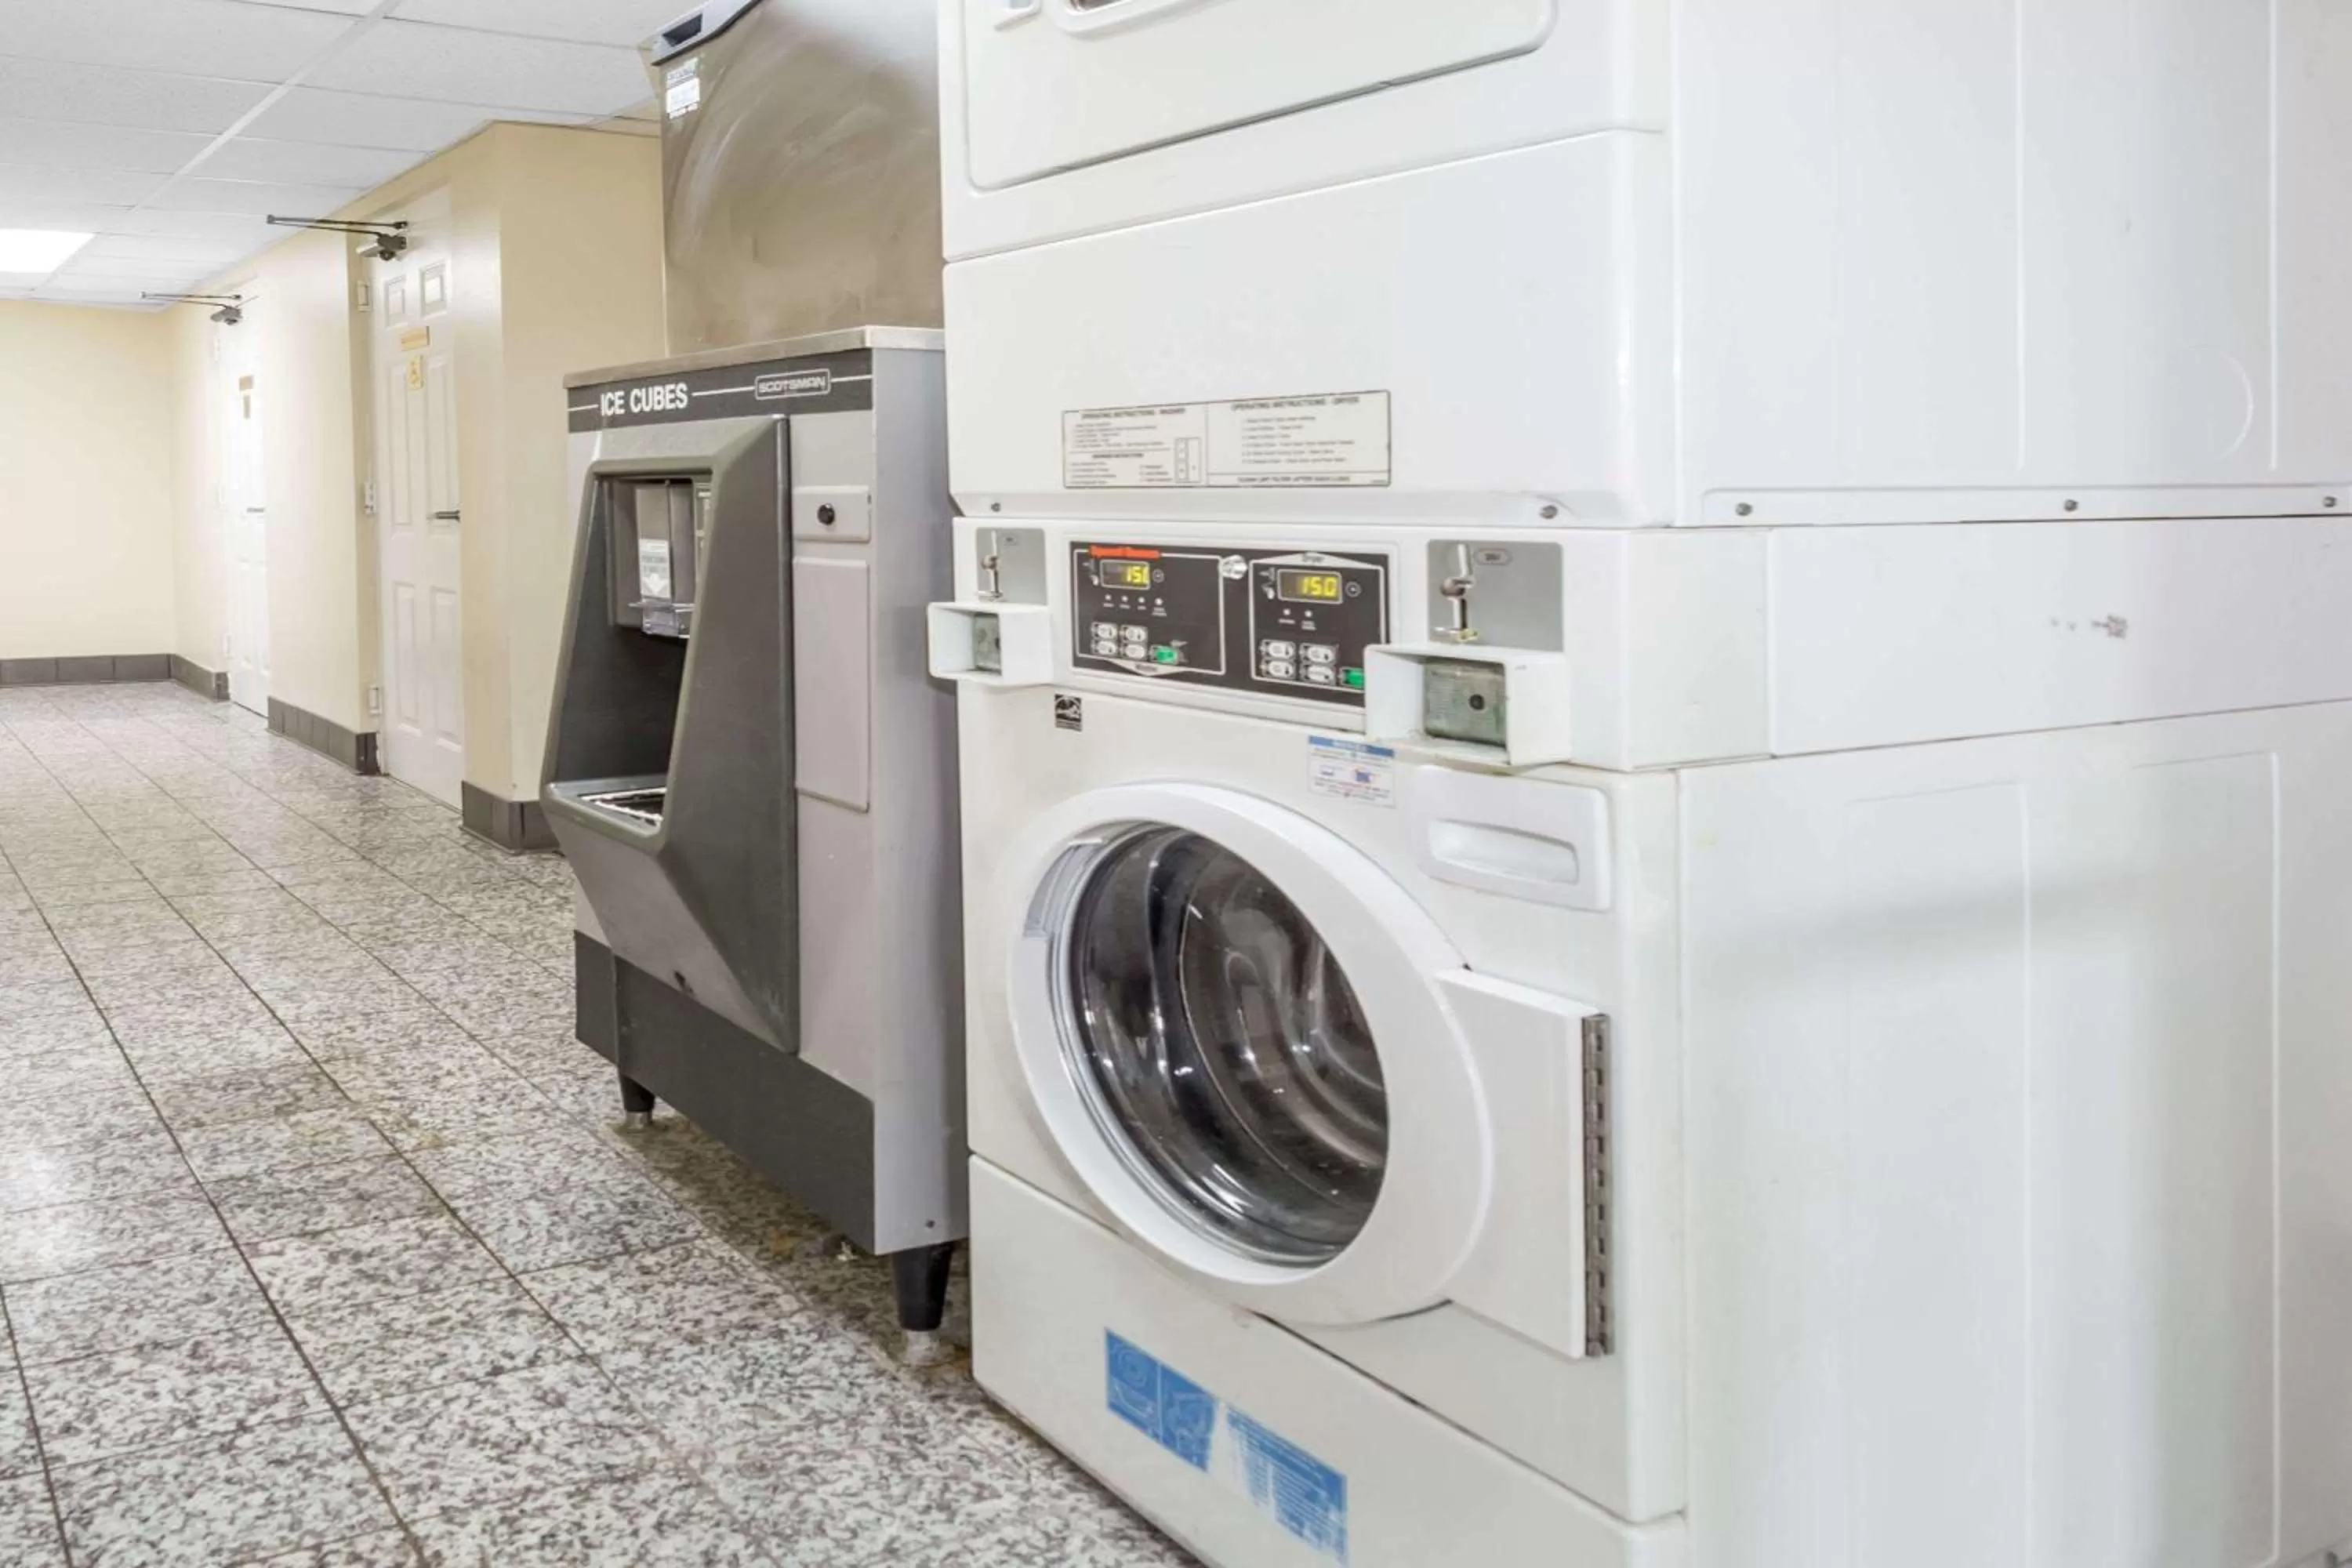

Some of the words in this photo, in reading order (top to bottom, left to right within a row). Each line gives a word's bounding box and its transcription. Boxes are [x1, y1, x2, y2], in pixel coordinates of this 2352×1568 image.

[758, 376, 826, 393] SCOTSMAN
[601, 390, 626, 416] ICE
[630, 382, 688, 413] CUBES
[1303, 575, 1338, 597] 150
